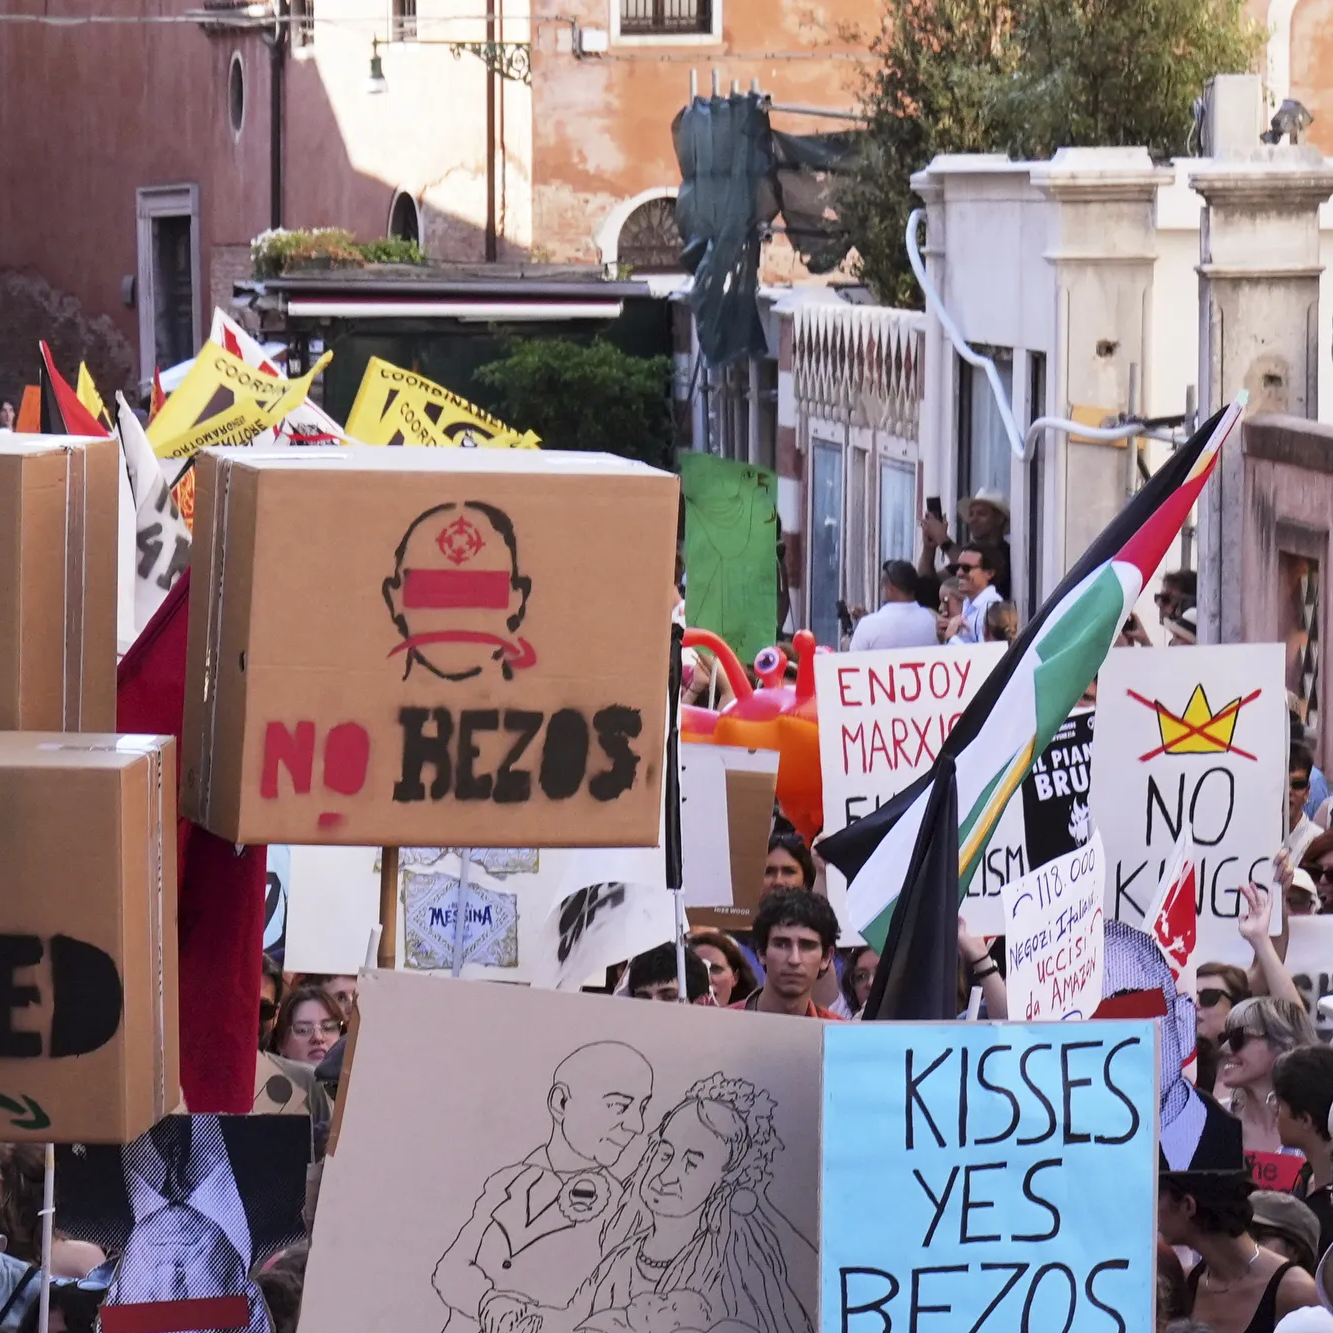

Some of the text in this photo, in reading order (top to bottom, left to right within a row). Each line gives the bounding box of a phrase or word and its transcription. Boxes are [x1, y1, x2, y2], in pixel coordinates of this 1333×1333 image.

[837, 659, 972, 707] ENJOY
[259, 702, 644, 803] NO BEZOS
[1034, 763, 1089, 801] BRU
[1051, 741, 1093, 769] PIAN
[1146, 766, 1235, 847] NO
[905, 1036, 1141, 1151] KISSES
[913, 1158, 1063, 1248] YES
